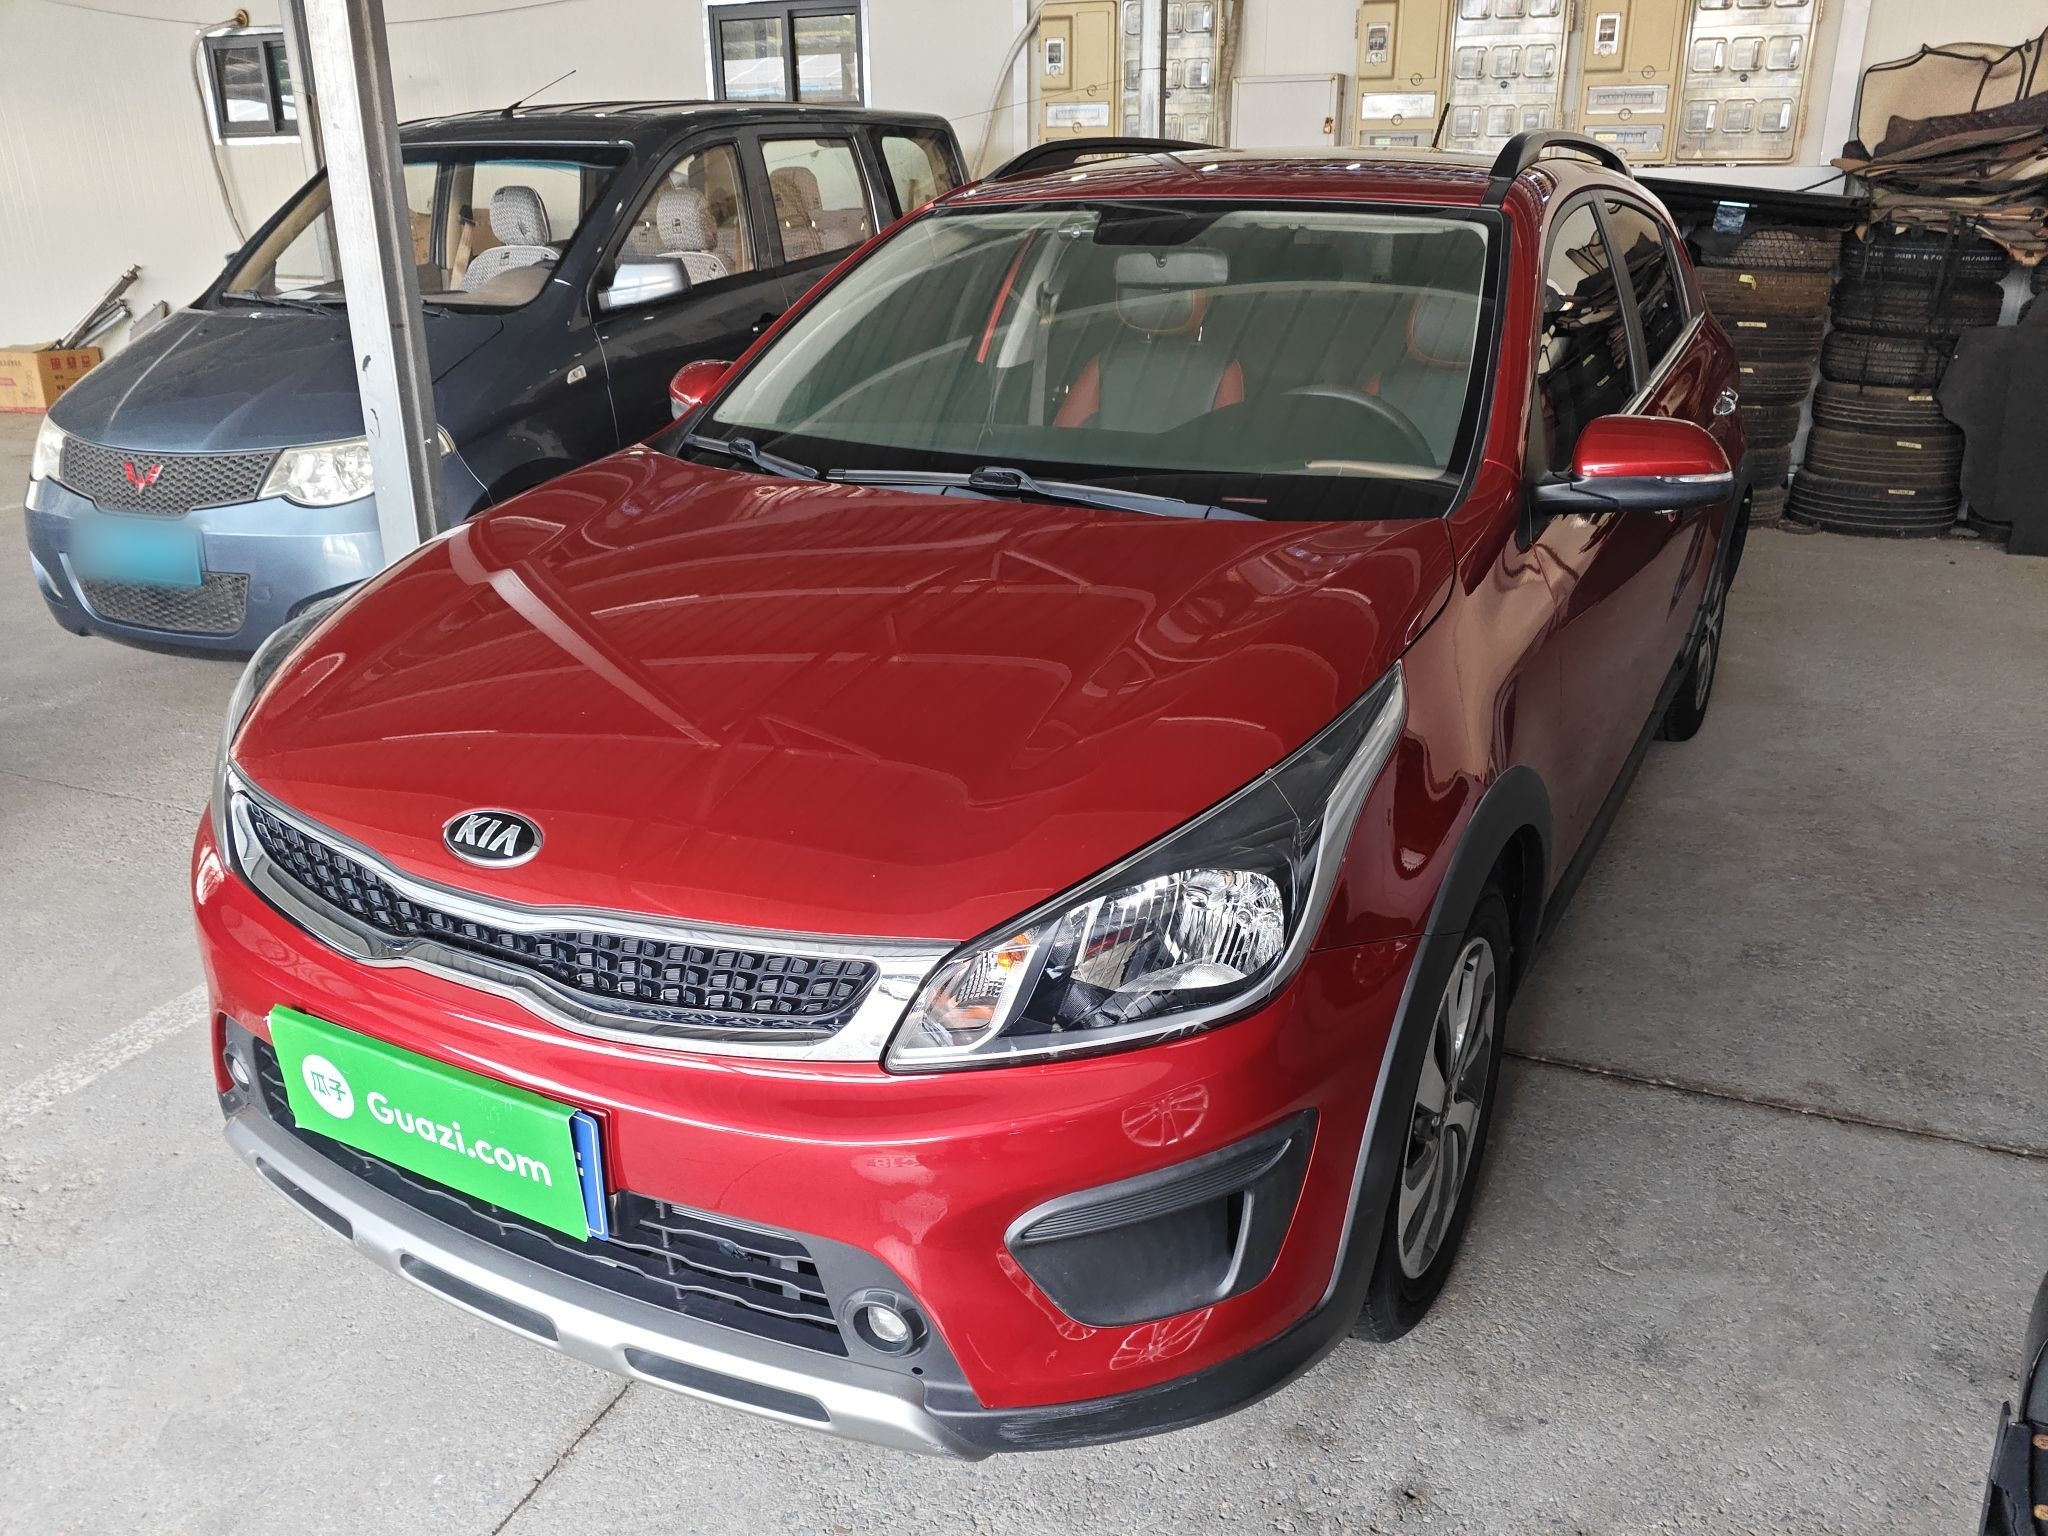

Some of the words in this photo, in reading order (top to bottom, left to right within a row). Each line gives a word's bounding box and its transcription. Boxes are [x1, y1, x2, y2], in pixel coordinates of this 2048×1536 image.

[454, 814, 521, 857] KIA
[310, 1070, 346, 1102] 瓜子
[366, 1091, 552, 1187] Guazi.com
